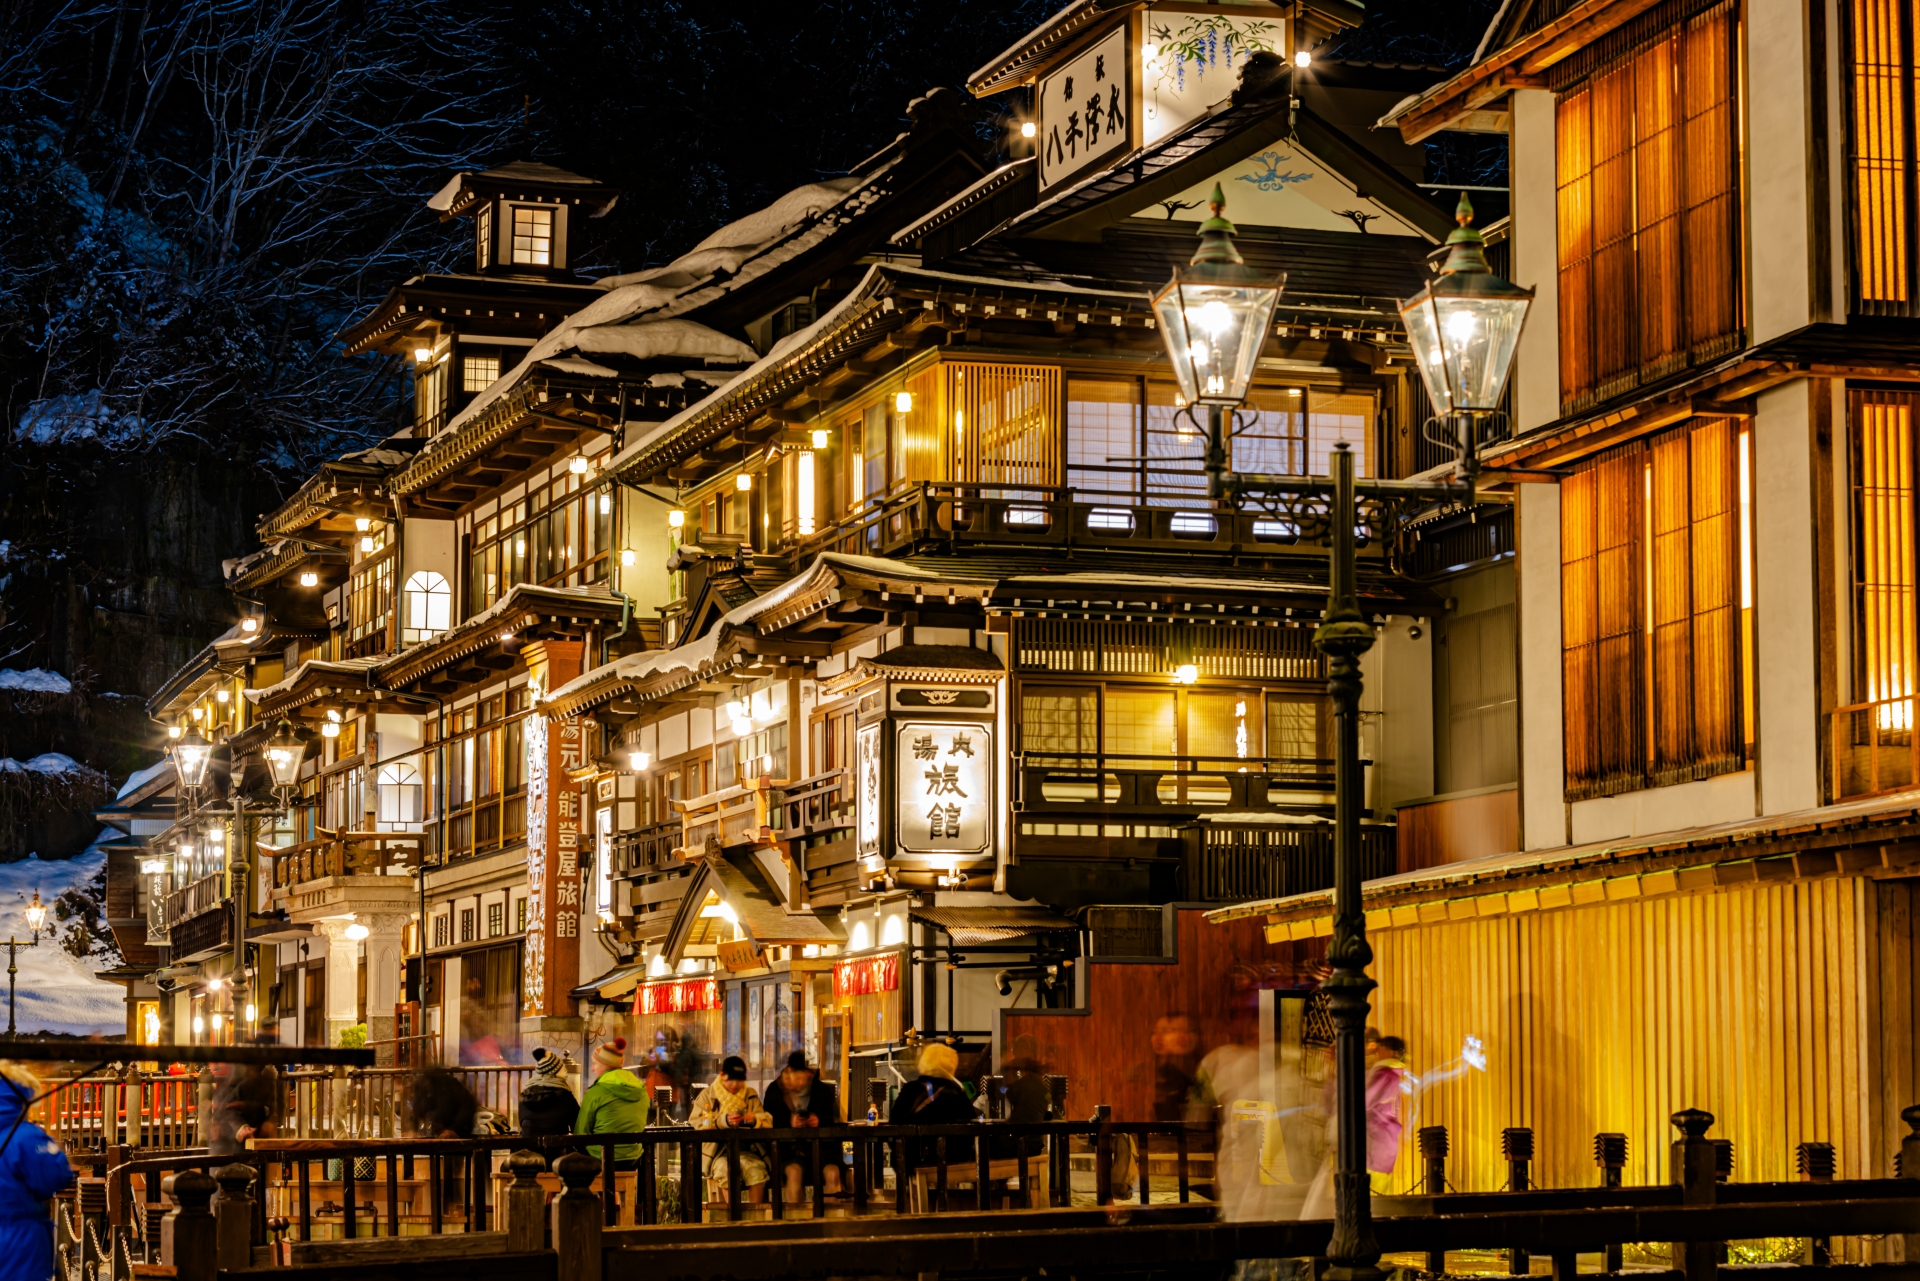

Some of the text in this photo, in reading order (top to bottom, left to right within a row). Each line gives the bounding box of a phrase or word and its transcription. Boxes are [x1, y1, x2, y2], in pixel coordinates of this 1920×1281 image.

[912, 731, 975, 762] 内湯
[556, 716, 580, 938] 湯元 能登屋旅館
[924, 761, 968, 840] 旅館
